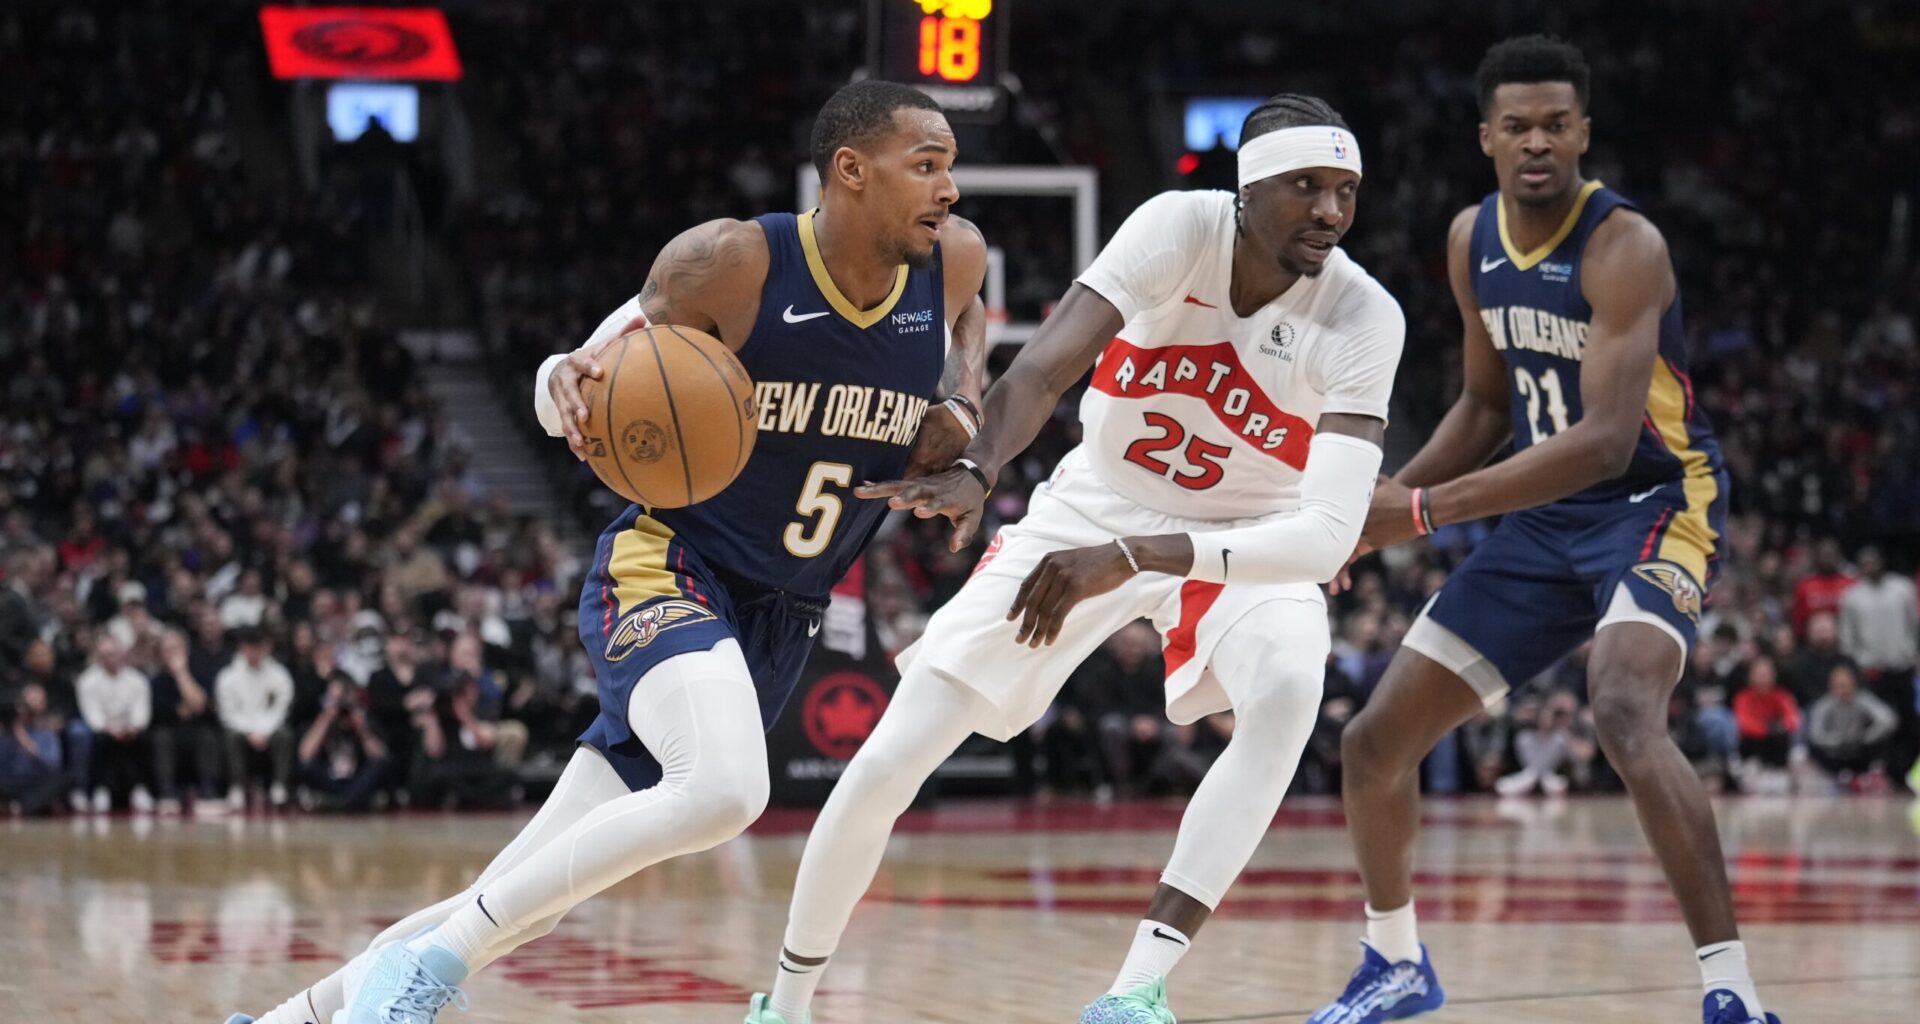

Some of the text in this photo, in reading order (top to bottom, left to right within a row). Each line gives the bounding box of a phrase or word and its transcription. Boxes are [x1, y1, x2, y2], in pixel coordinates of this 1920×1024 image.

[919, 15, 980, 82] 18
[892, 309, 933, 325] NEWAGE
[898, 324, 929, 334] GARAGE
[1258, 344, 1277, 357] Sun
[820, 384, 929, 447] ORLEANS
[1114, 356, 1289, 450] RAPTORS
[1514, 366, 1568, 445] 21
[1123, 411, 1233, 491] 25
[783, 460, 853, 558] 5
